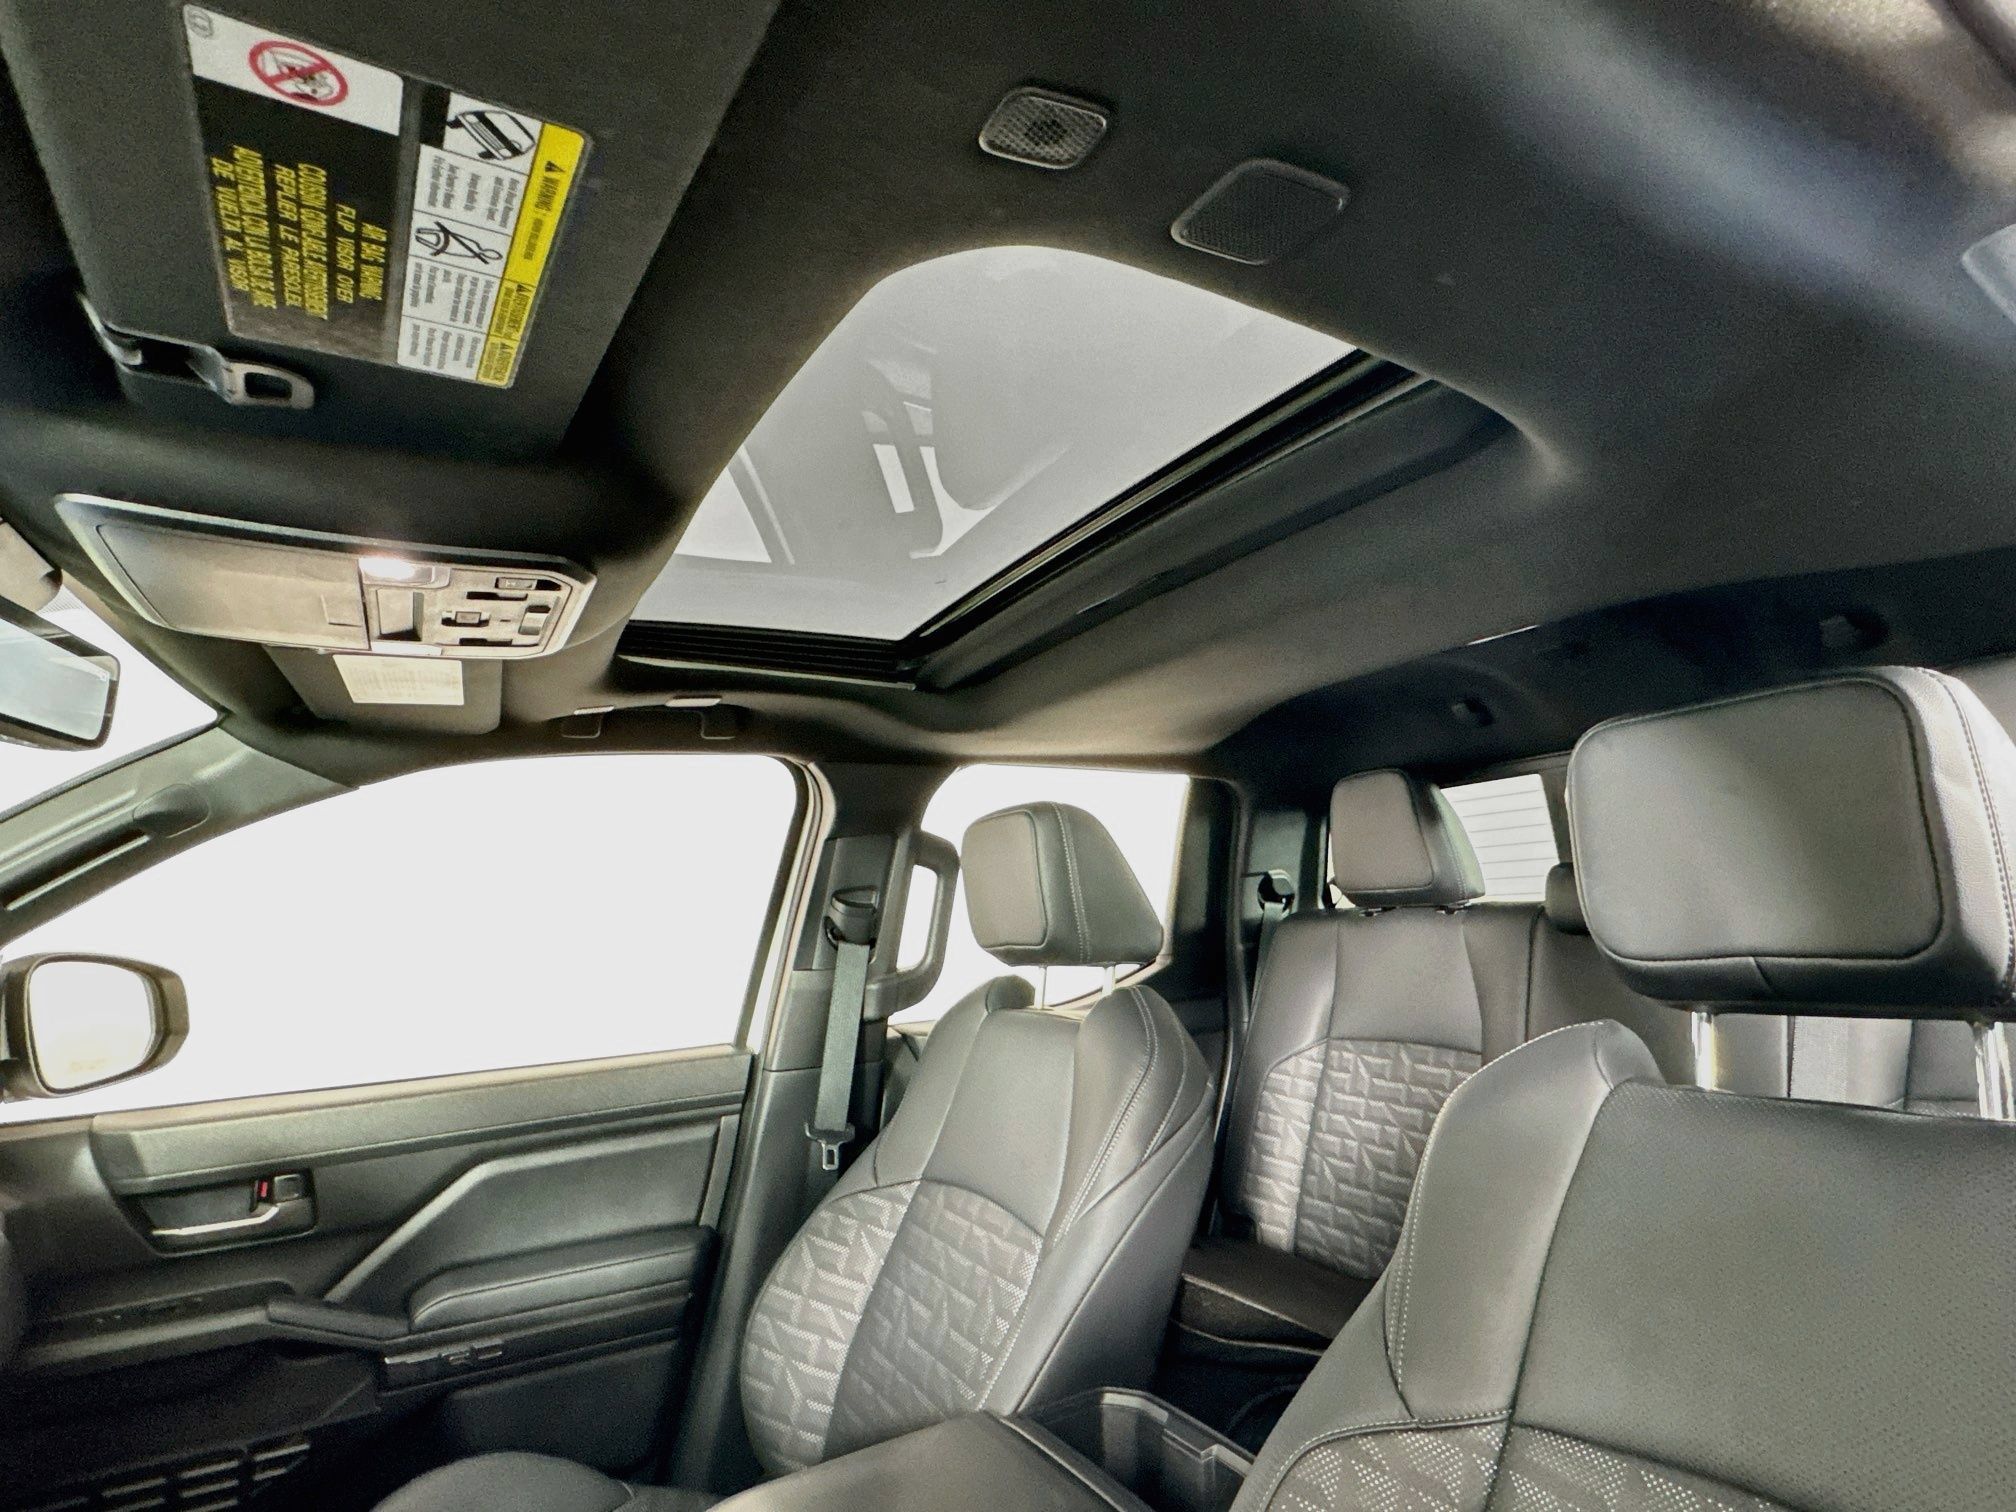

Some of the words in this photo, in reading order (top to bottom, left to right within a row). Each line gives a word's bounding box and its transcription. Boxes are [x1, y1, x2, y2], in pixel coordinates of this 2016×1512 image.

[210, 157, 235, 181] DE
[232, 144, 267, 217] ADVERTENCIA
[274, 163, 298, 221] REPLIER
[297, 161, 327, 210] COUSSIN
[214, 185, 241, 233] VUELTA
[335, 202, 355, 233] FLIP
[240, 213, 270, 238] CON
[278, 224, 299, 242] LE
[223, 235, 245, 254] AL
[244, 234, 271, 251] LA
[335, 235, 354, 271] VISOR
[360, 241, 385, 263] BAG
[226, 258, 249, 292] VISOR
[249, 275, 275, 291] DE
[336, 272, 353, 304] OVER
[358, 263, 383, 301] WARNING
